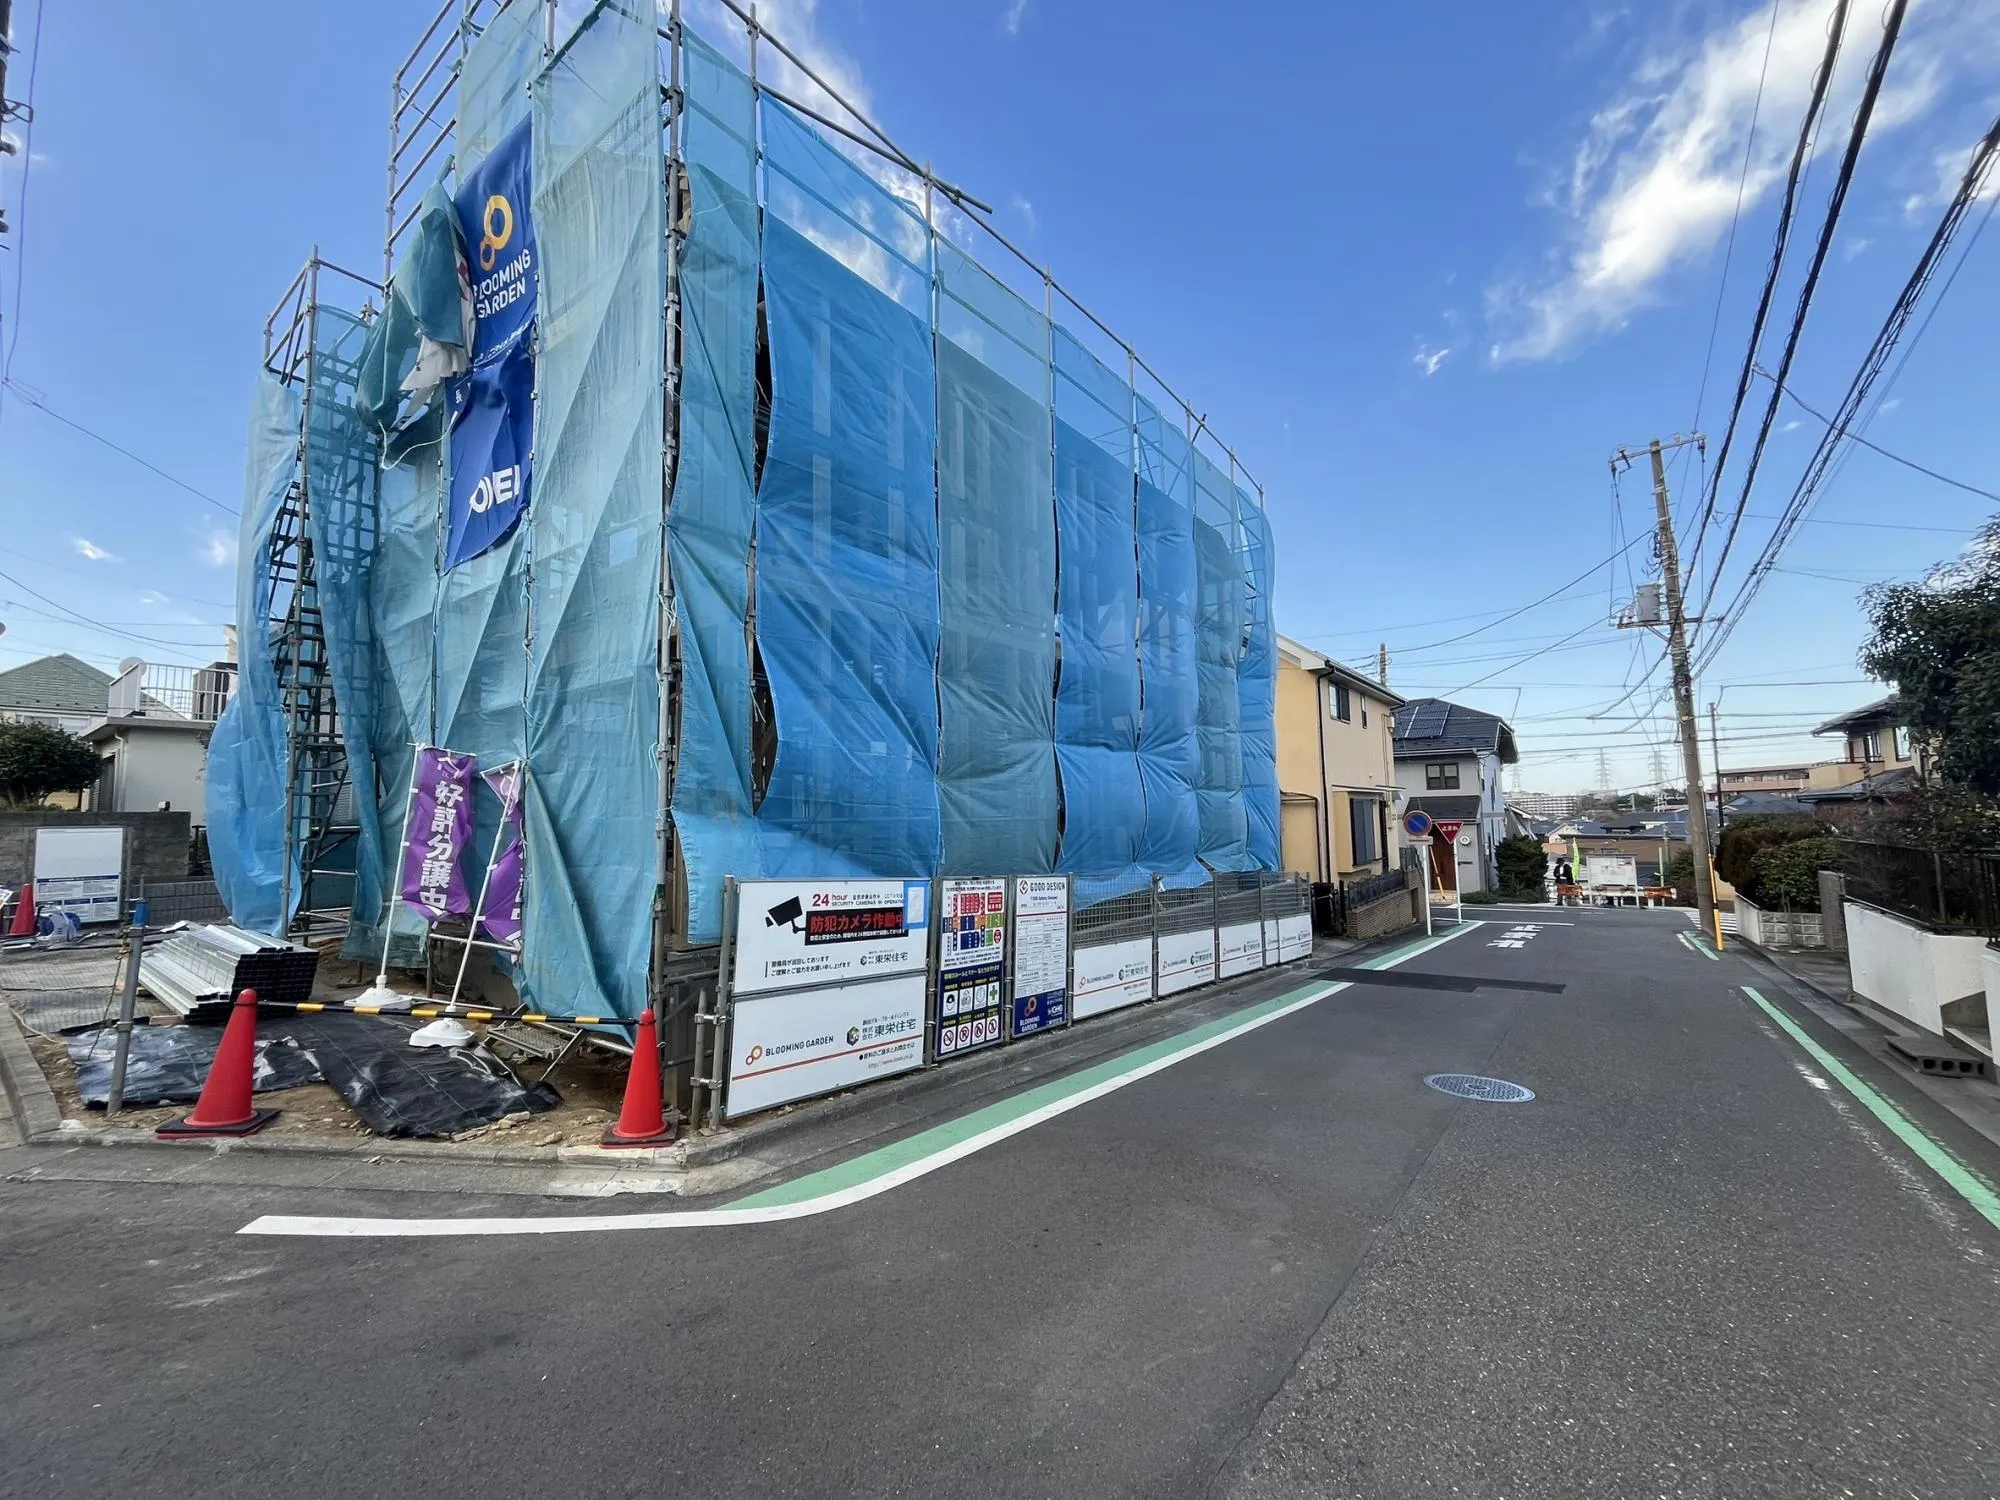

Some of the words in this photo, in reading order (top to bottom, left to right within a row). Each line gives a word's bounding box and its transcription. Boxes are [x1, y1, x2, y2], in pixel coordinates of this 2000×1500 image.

[419, 780, 464, 910] 好評分譲中
[1030, 882, 1046, 892] GOOD
[1046, 881, 1066, 892] DESIGN
[812, 893, 830, 907] 24
[831, 893, 848, 901] hour
[875, 951, 908, 964] 東栄住宅
[874, 1018, 917, 1038] 東栄住宅
[765, 1041, 805, 1057] BLOOMING
[805, 1035, 834, 1048] GARDEN
